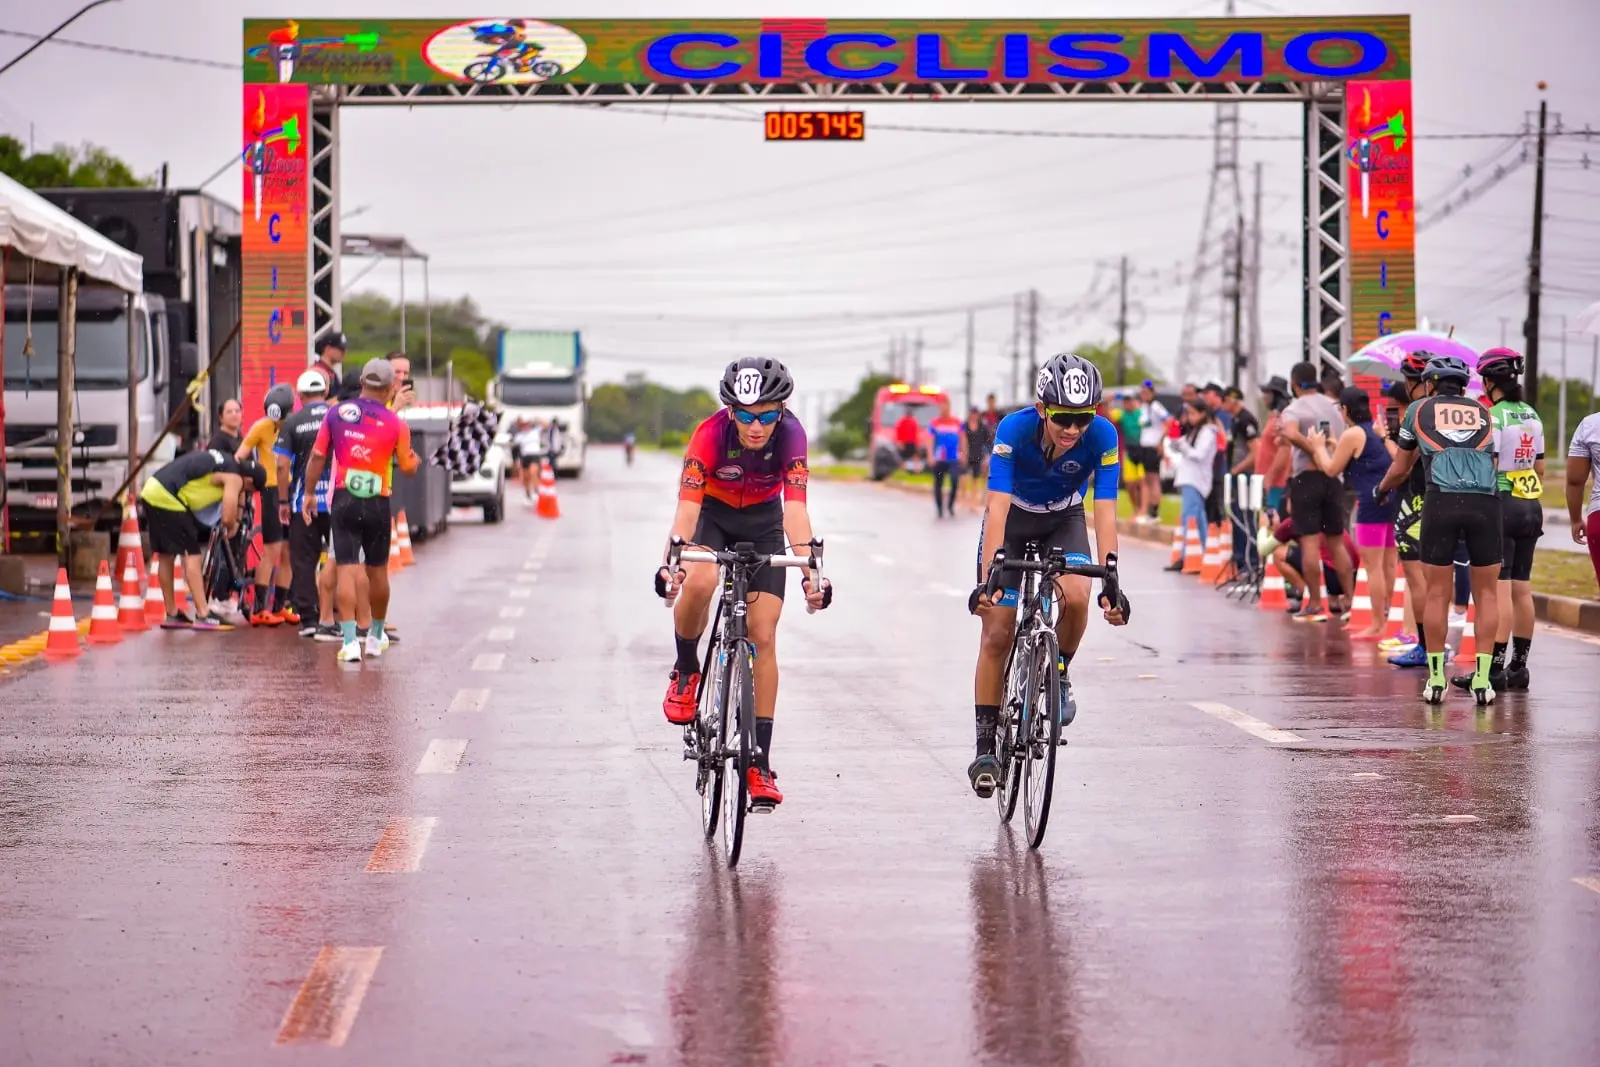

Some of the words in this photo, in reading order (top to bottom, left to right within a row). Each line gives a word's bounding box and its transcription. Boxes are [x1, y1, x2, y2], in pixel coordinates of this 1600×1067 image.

[647, 31, 1388, 80] CICLISMO
[766, 113, 864, 139] 005745
[737, 374, 760, 395] 137
[1065, 374, 1088, 395] 139
[1439, 408, 1476, 426] 103
[1514, 448, 1536, 459] EPIC
[349, 475, 376, 494] 61
